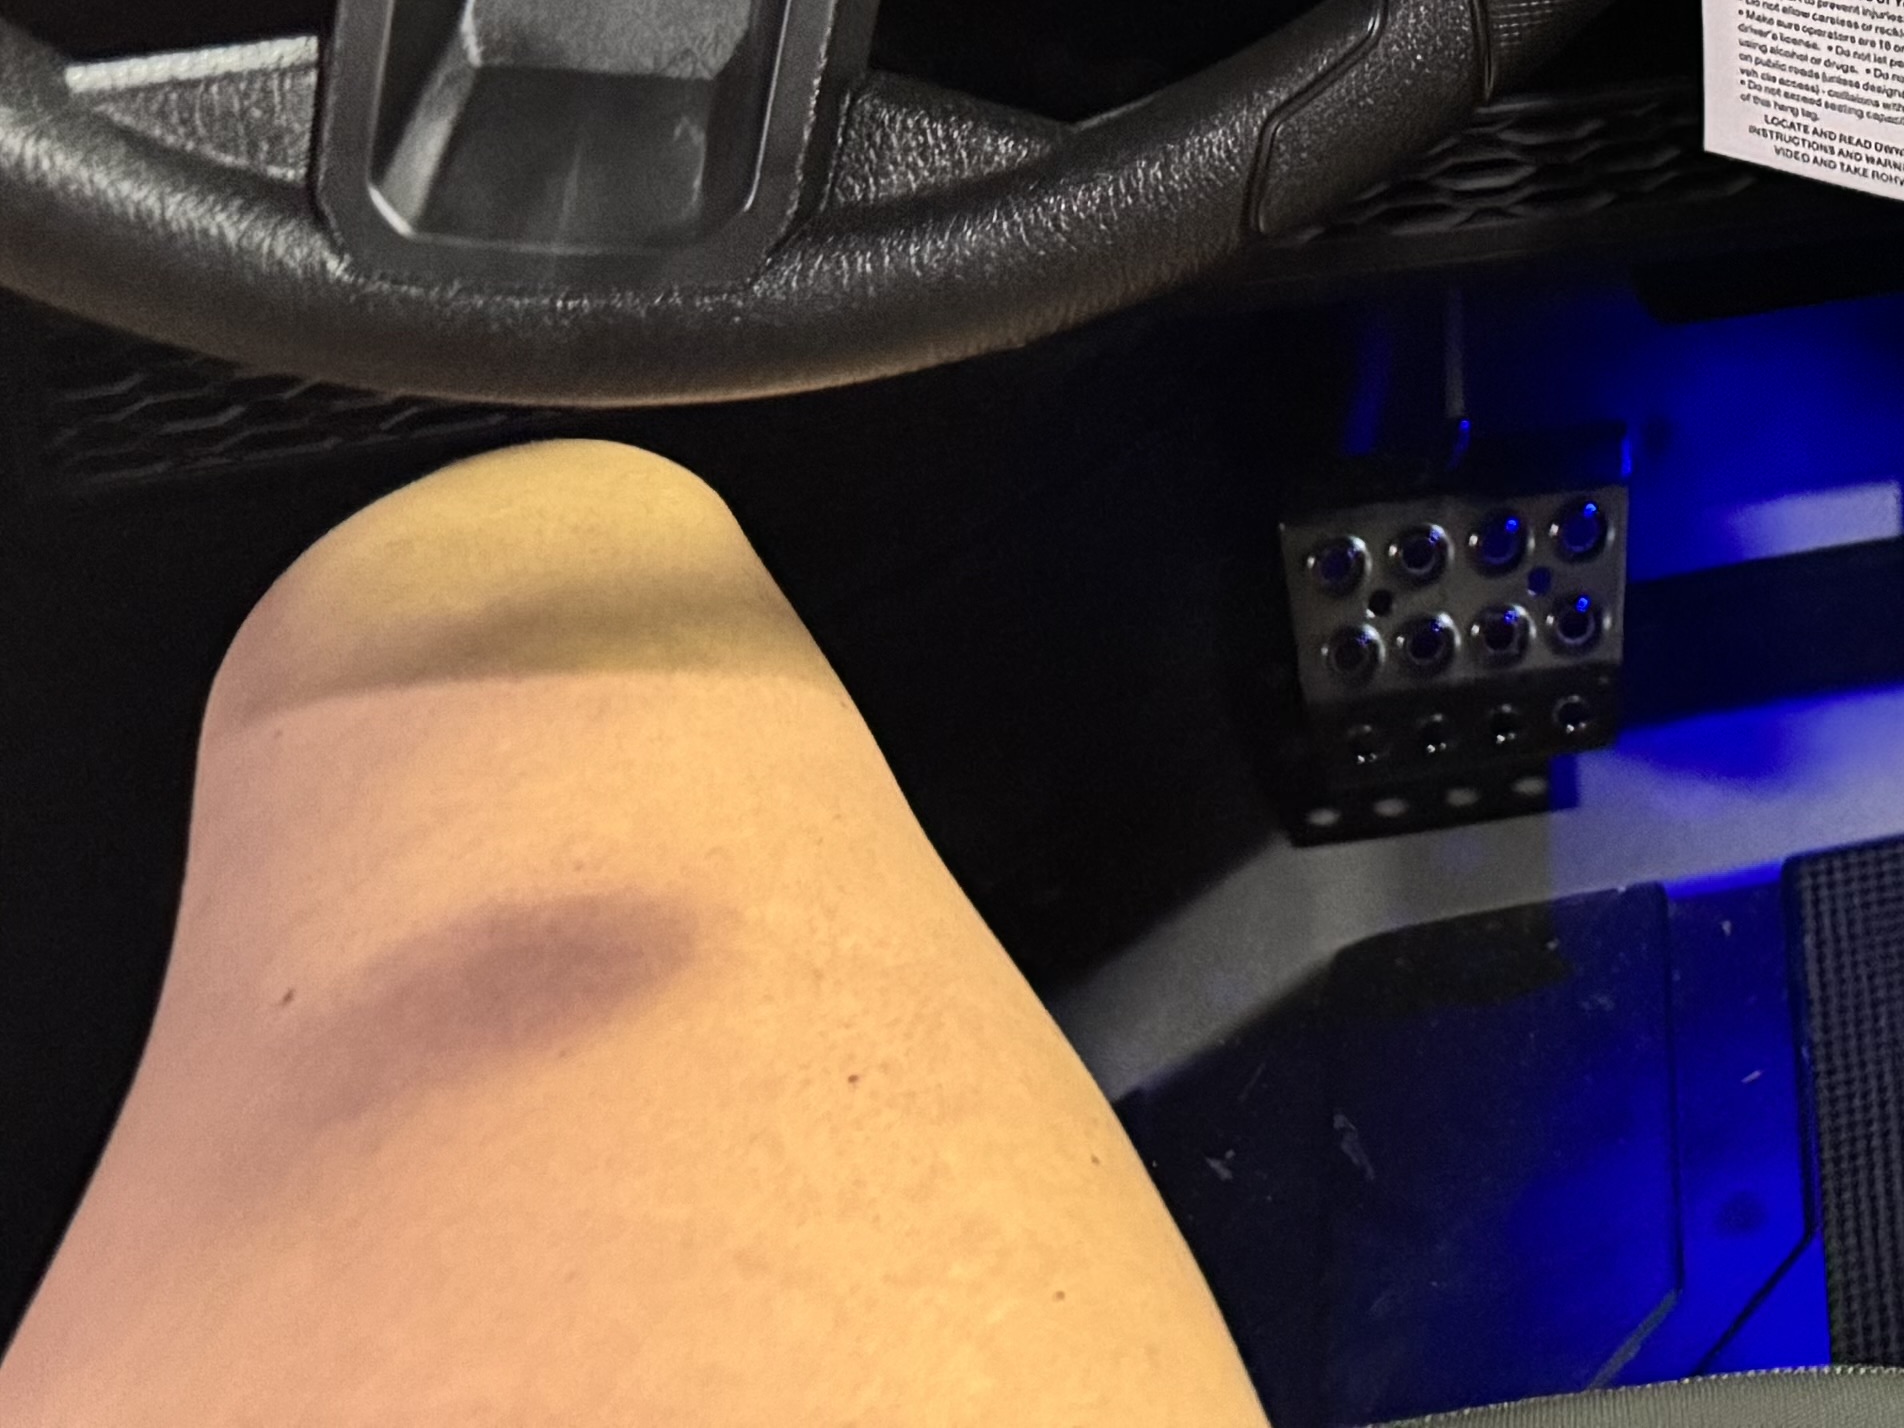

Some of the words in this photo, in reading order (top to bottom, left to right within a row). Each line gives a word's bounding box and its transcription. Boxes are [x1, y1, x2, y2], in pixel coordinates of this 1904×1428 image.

[1764, 115, 1809, 134] LOCATE
[1812, 127, 1836, 141] AND
[1839, 133, 1872, 149] READ
[1774, 146, 1810, 163] VIDEO
[1813, 156, 1837, 169] AND
[1840, 162, 1868, 178] TAKE
